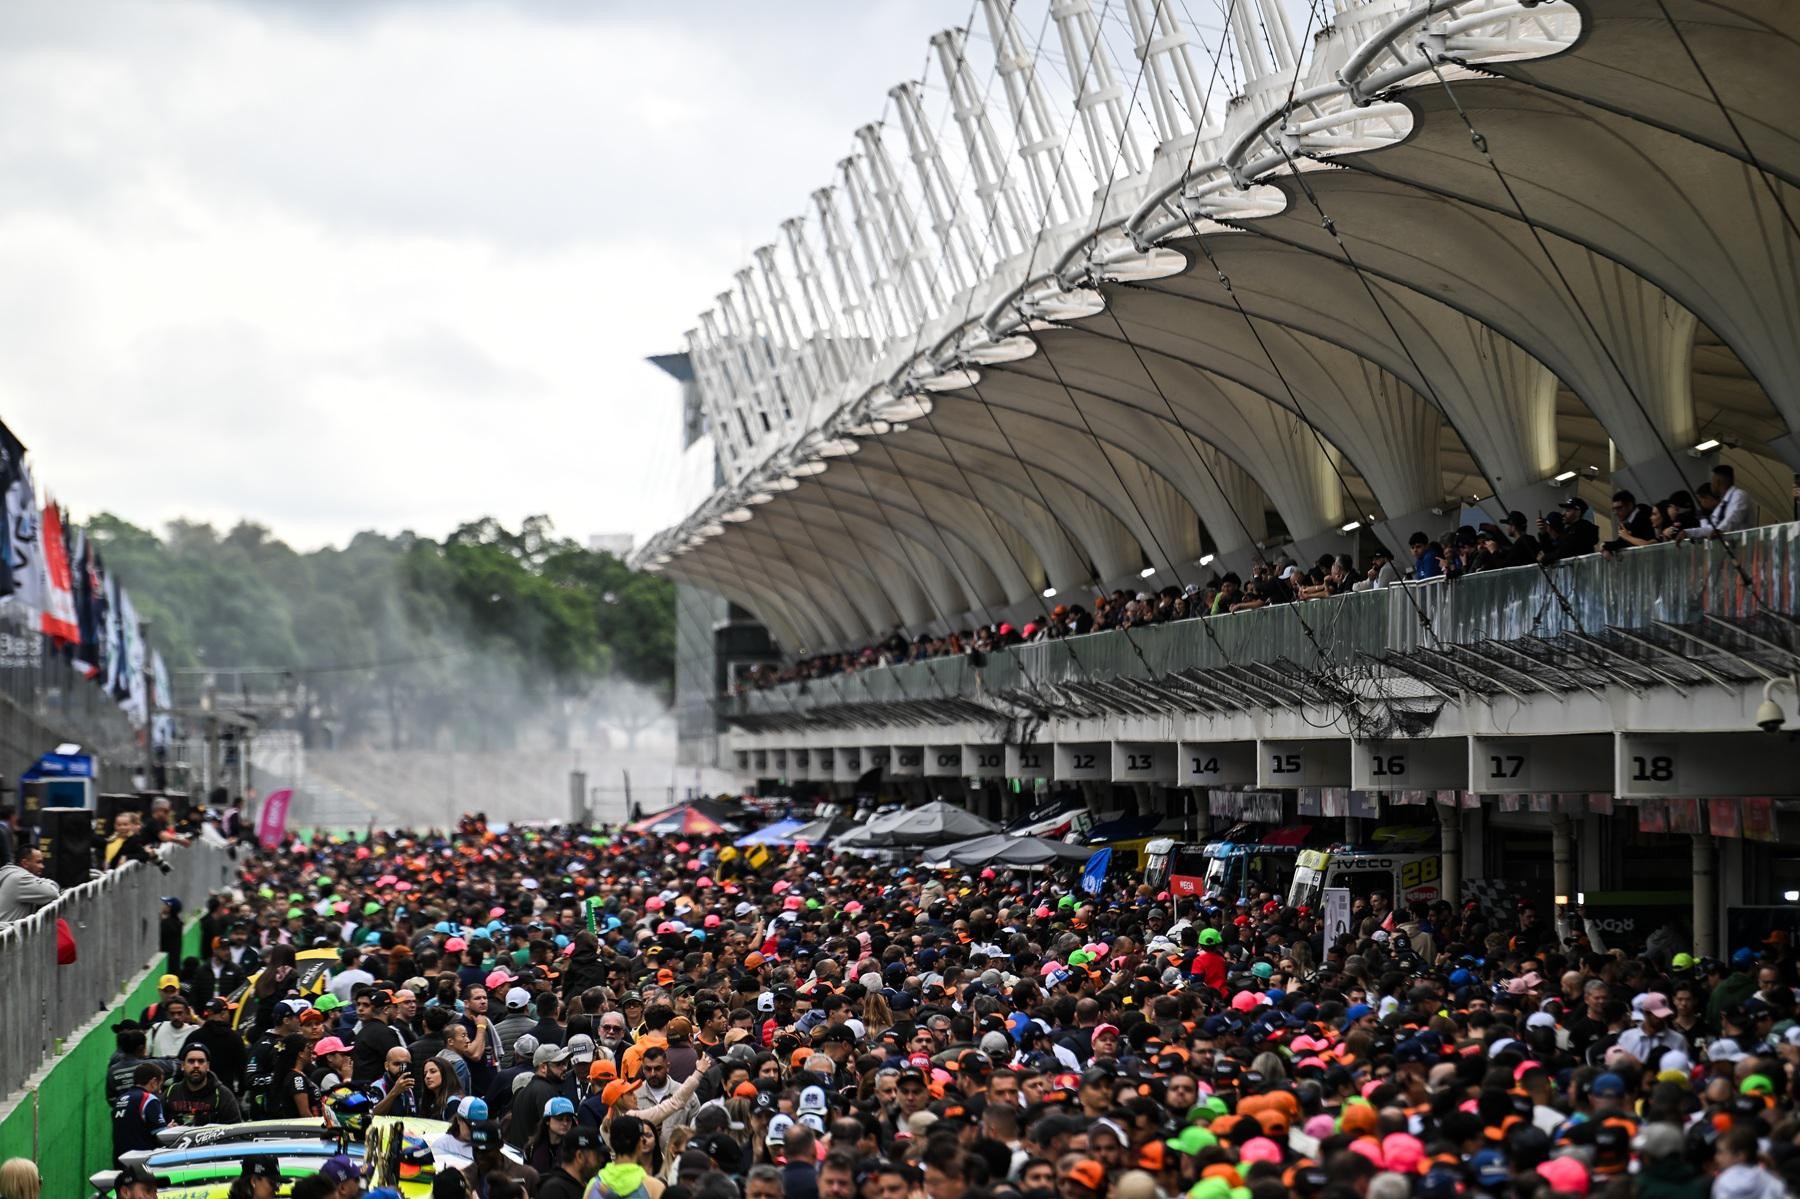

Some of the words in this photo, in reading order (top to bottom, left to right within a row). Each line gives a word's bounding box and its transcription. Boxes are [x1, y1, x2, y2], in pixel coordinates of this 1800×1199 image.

[938, 754, 960, 767] 09
[979, 754, 1000, 767] 10
[1020, 754, 1040, 768] 11
[1073, 754, 1095, 769] 12
[1127, 754, 1152, 770] 13
[1192, 757, 1220, 774] 14
[1272, 755, 1301, 773] 15
[1372, 755, 1405, 775] 16
[1490, 756, 1524, 778] 17
[1632, 756, 1673, 781] 18
[1337, 859, 1393, 869] IVECO
[1402, 856, 1440, 889] 28
